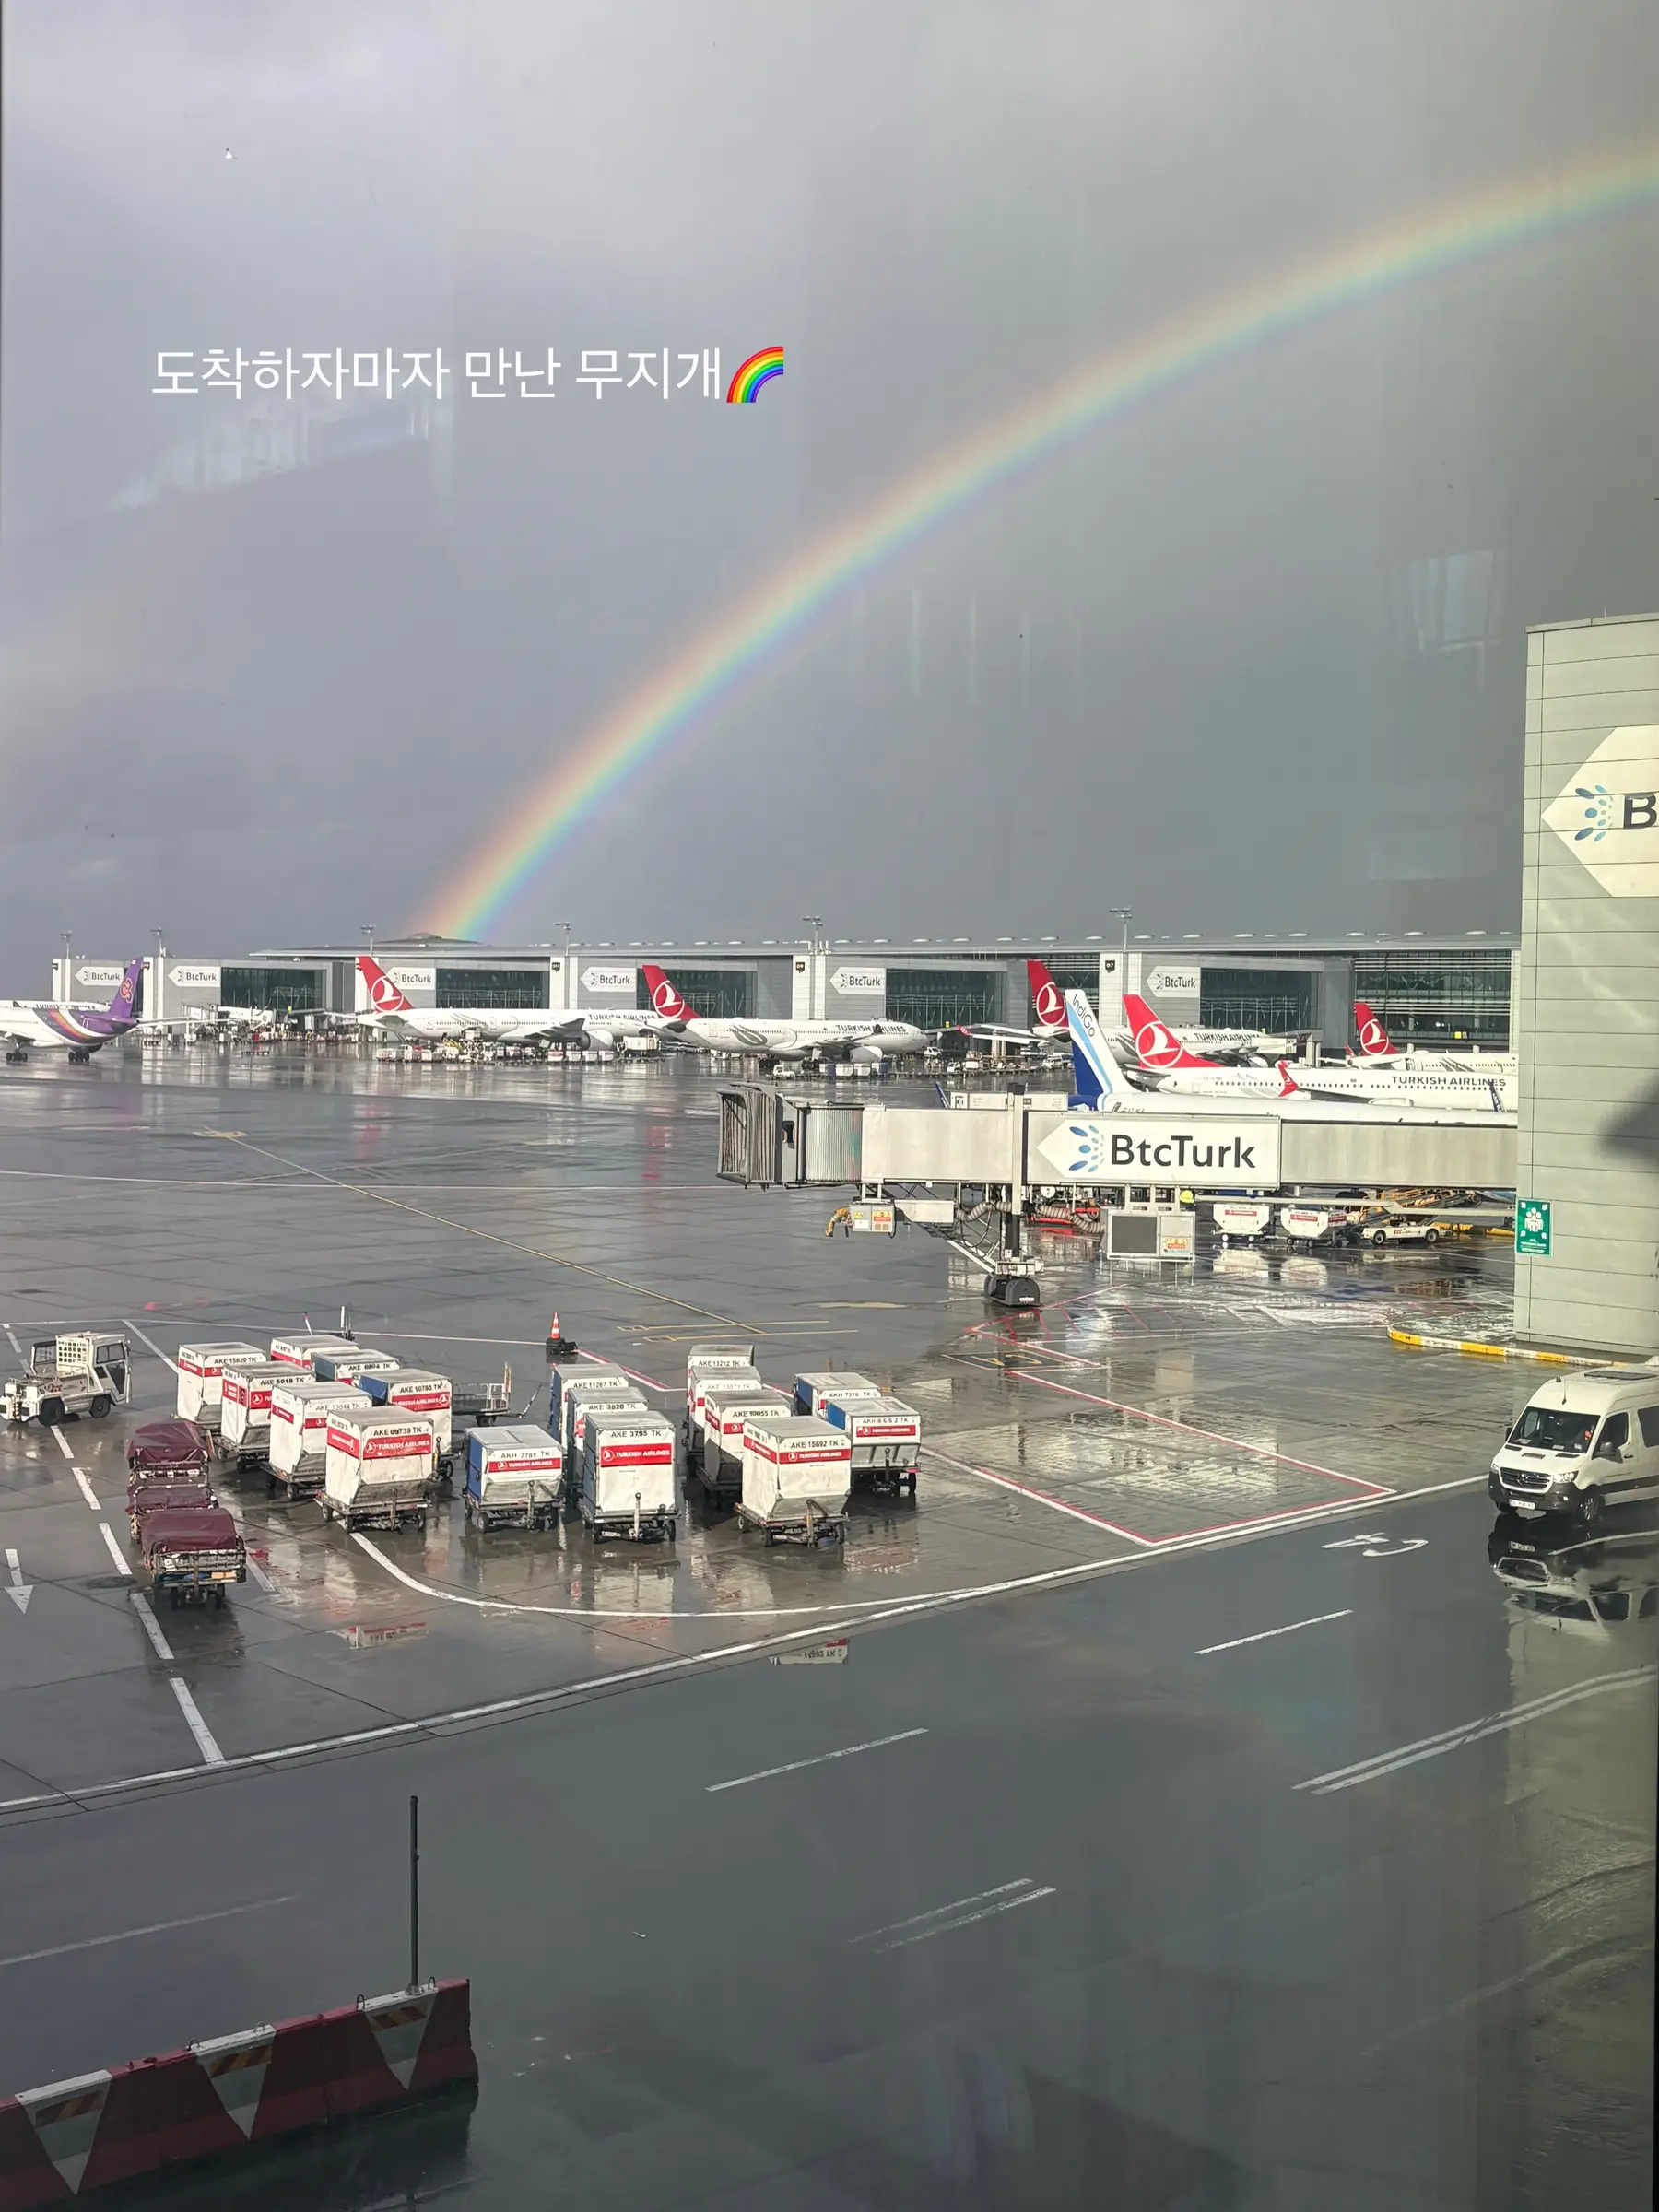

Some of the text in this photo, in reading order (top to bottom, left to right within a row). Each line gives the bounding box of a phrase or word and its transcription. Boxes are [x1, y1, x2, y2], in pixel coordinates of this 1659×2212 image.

[91, 972, 121, 981] BtcTurk
[186, 972, 217, 981] BtcTurk
[401, 973, 431, 983] BtcTurk
[599, 974, 630, 984] BtcTurk
[849, 975, 881, 986] BtcTurk
[1164, 976, 1196, 988] BtcTurk
[1072, 994, 1096, 1038] IndiGo
[836, 1024, 871, 1032] TURKISH
[1194, 1032, 1229, 1041] TURKISH
[1391, 1076, 1506, 1087] TURKISH AIRLINES
[1111, 1134, 1256, 1169] BtcTurk
[404, 1441, 429, 1449] AIRLINES
